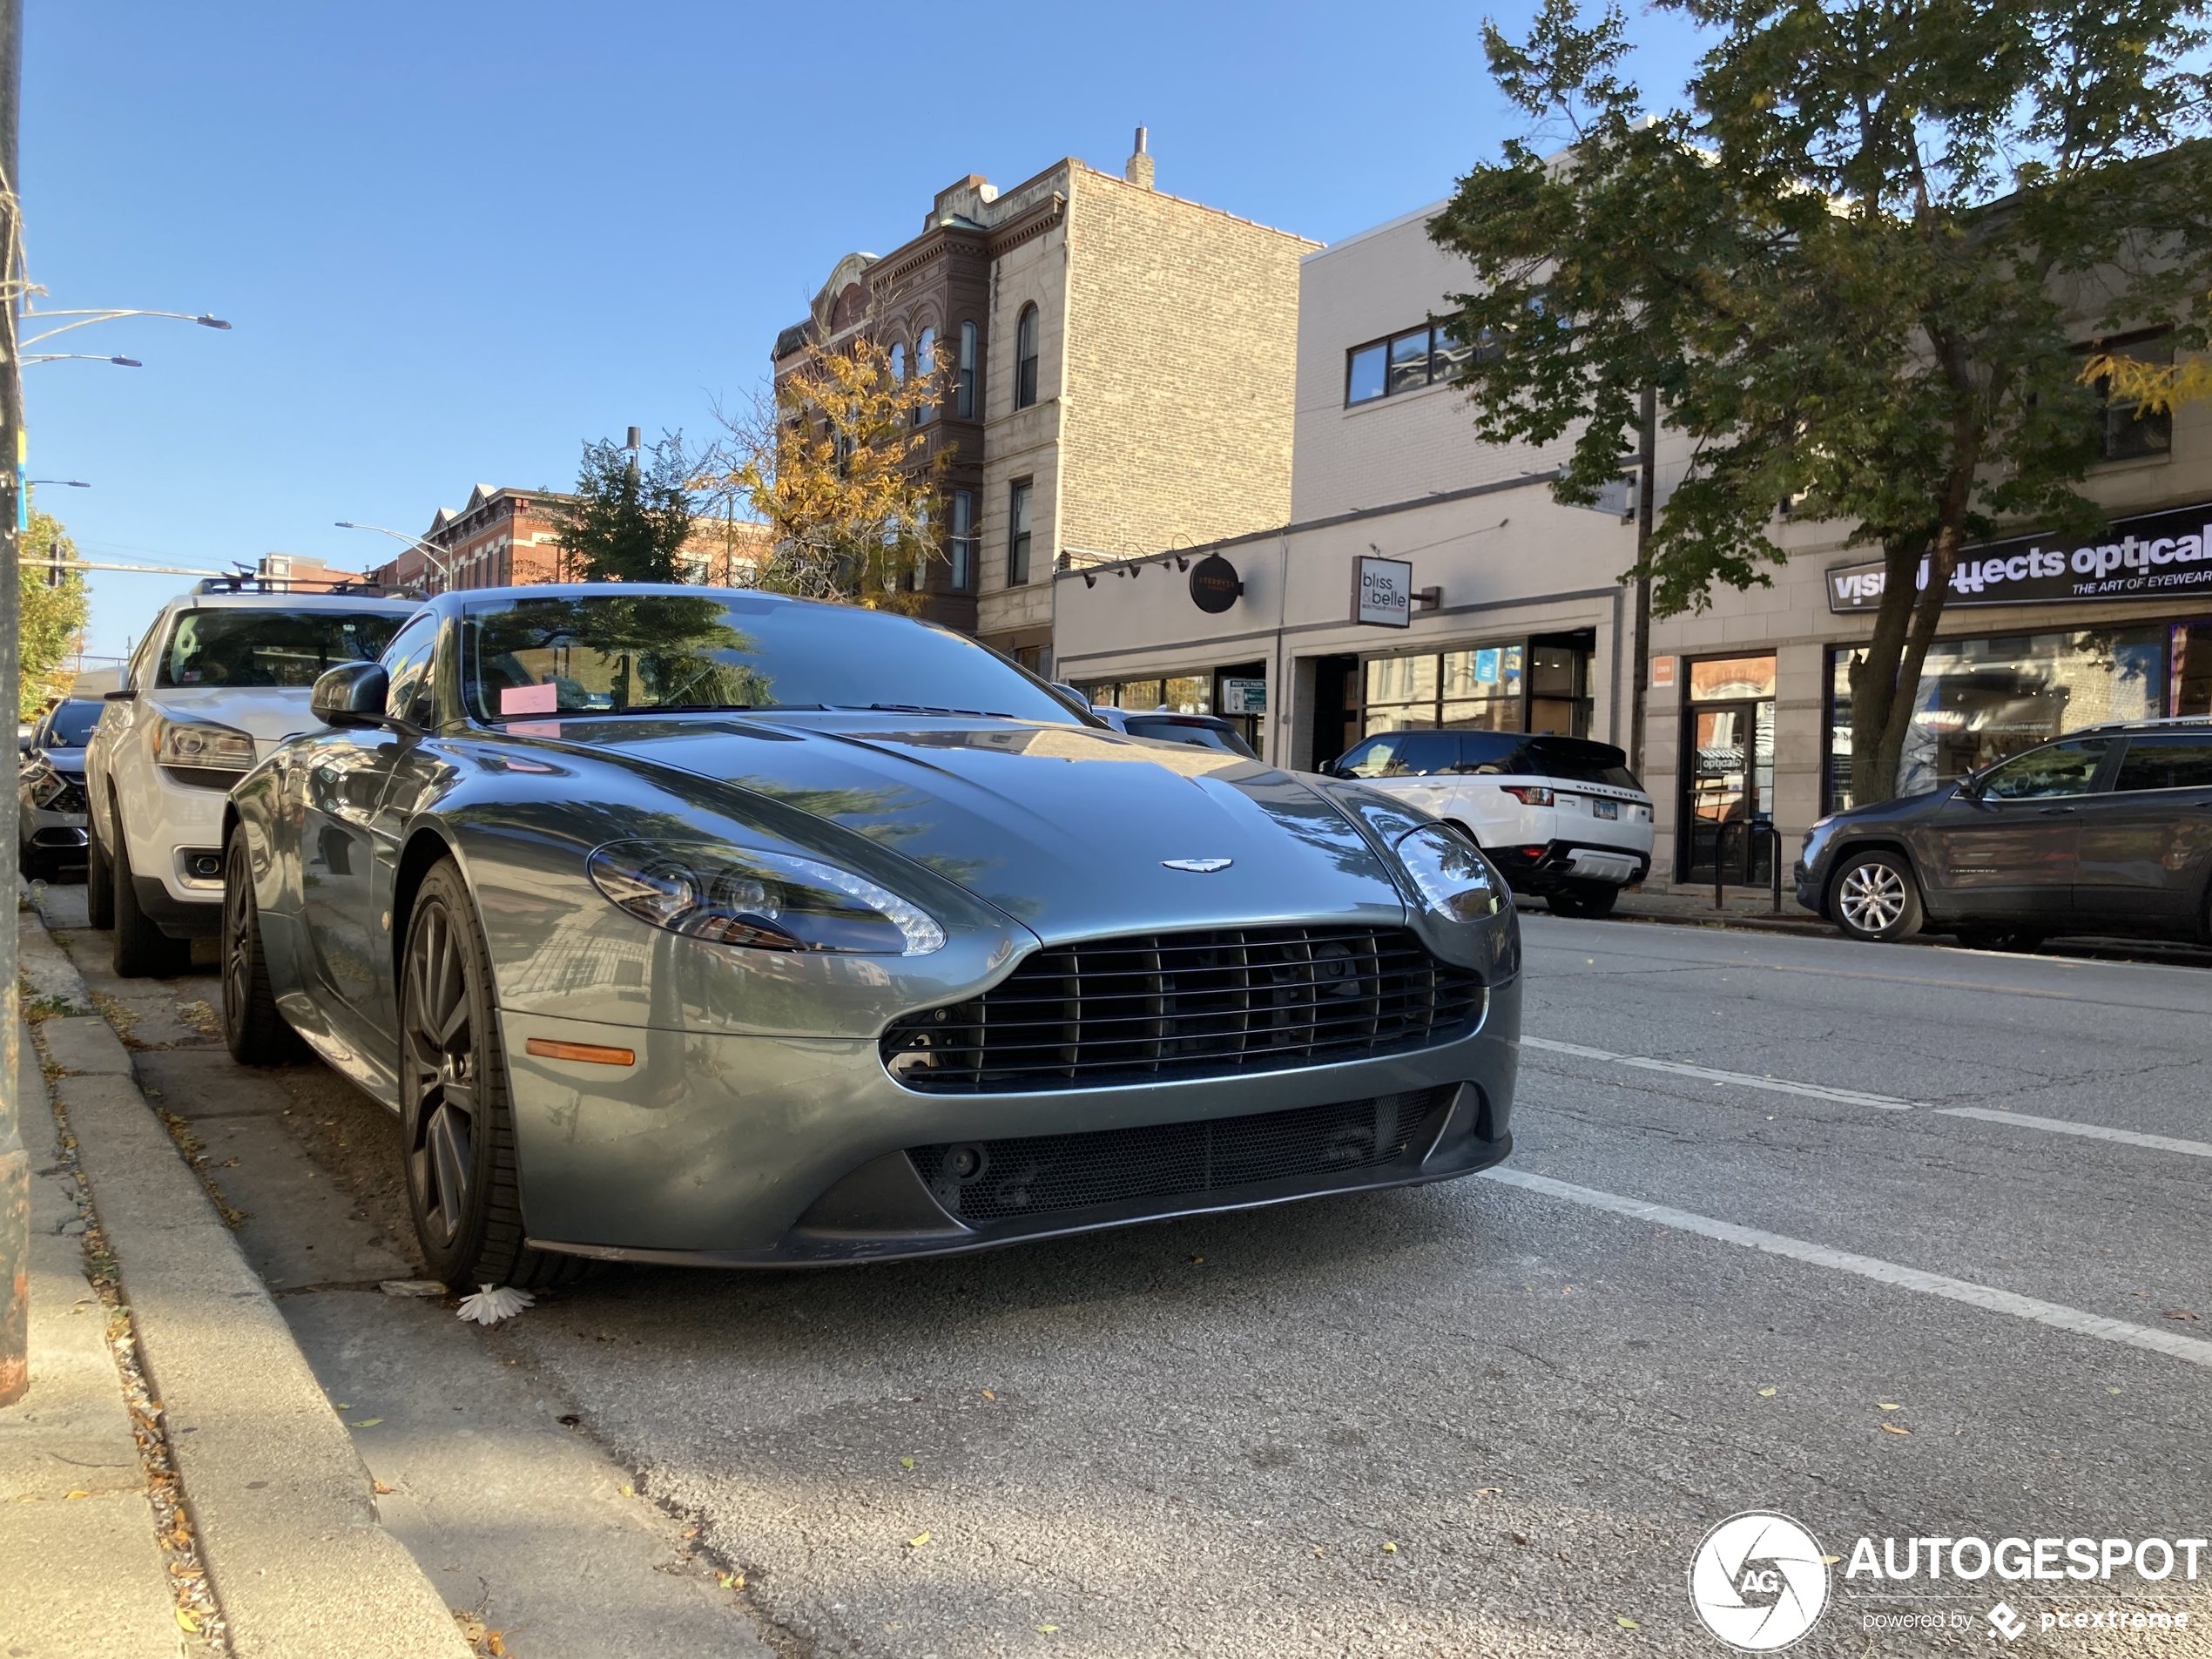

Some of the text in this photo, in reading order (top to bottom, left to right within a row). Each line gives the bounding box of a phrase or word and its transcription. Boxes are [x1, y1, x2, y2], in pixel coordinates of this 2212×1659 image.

[1835, 523, 2212, 606] visl ffects optical
[1363, 571, 1393, 590] bliss
[2073, 570, 2212, 595] THE ART OF EYEWEAR
[1372, 589, 1406, 607] belle
[1703, 757, 1736, 770] optical
[1576, 785, 1639, 799] RANGE ROVER
